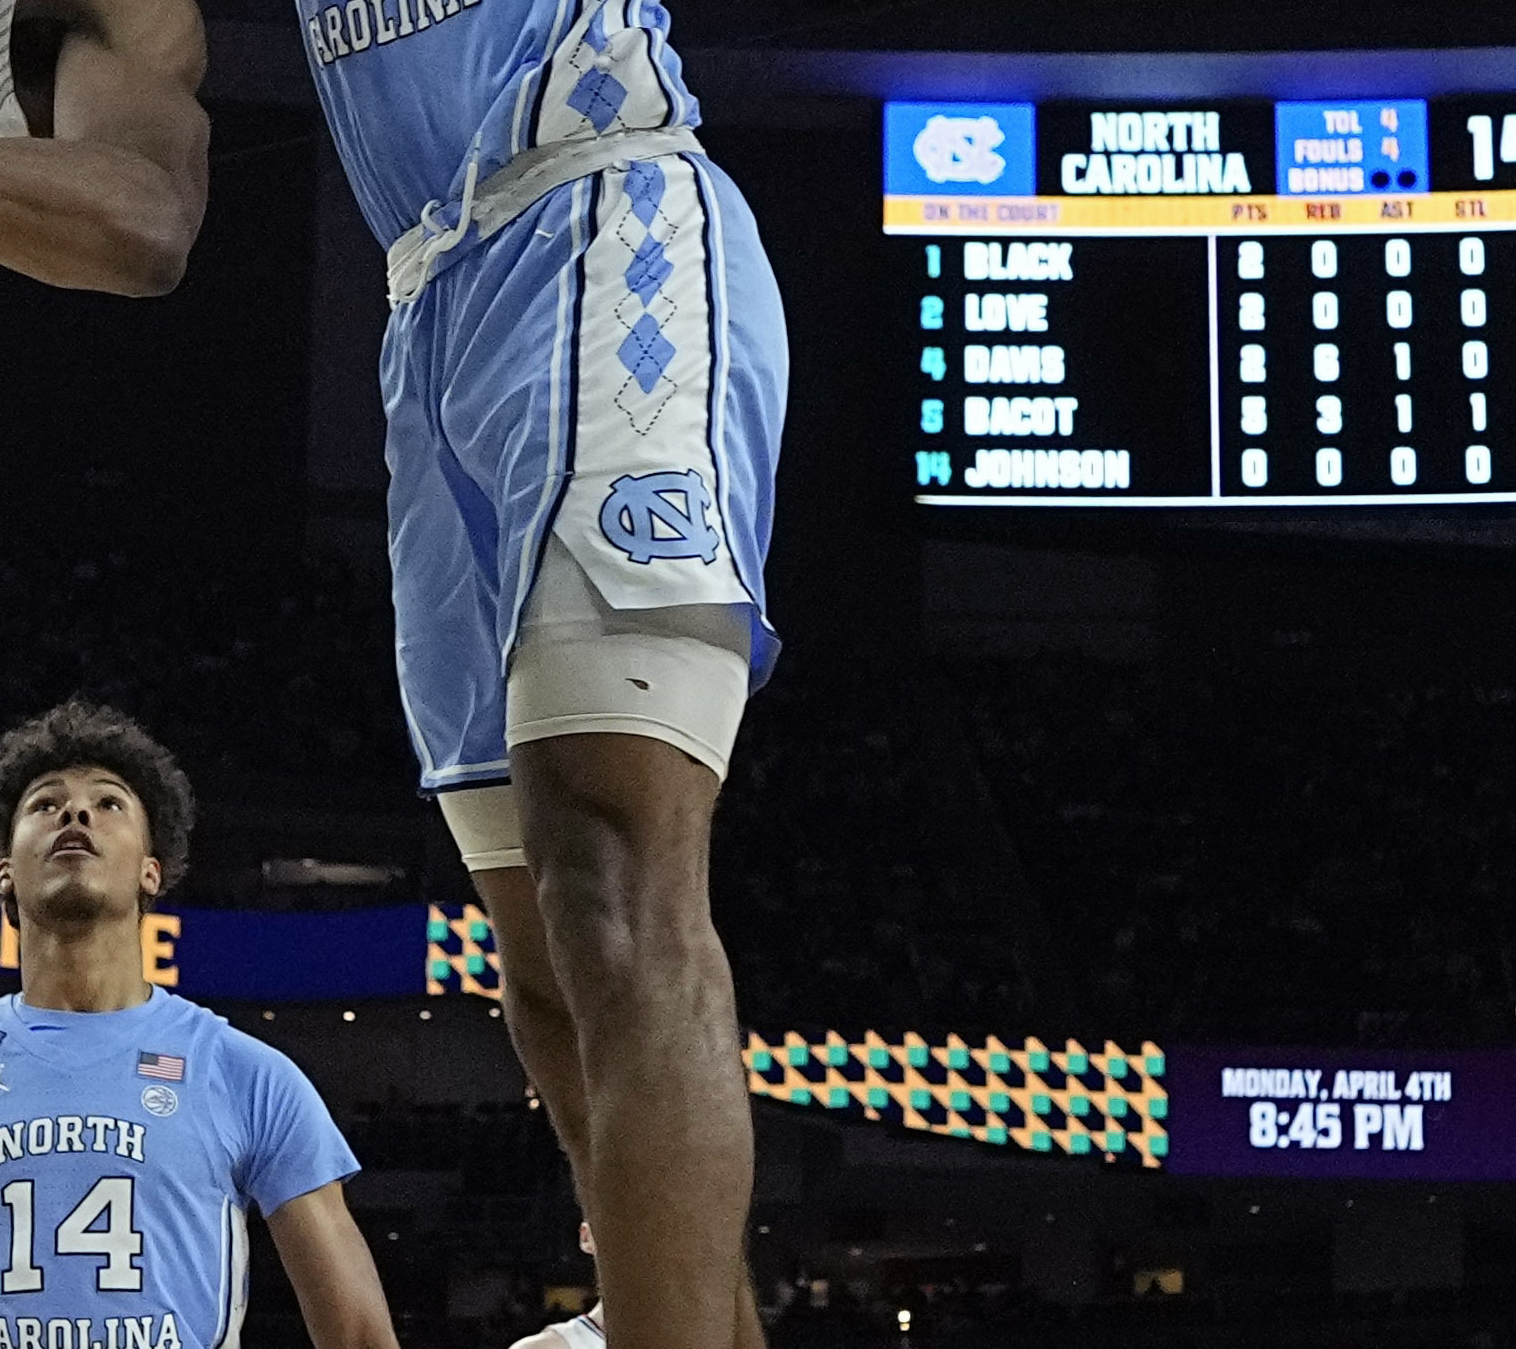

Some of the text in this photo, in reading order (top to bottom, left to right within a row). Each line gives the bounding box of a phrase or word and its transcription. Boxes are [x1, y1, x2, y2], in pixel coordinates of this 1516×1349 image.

[1091, 112, 1219, 151] NORTH
[1323, 107, 1398, 134] TOL 4
[1294, 137, 1399, 163] FOULS 4
[1061, 153, 1251, 193] CAROLINA
[1288, 167, 1364, 192] BONUS
[1381, 201, 1414, 218] AST
[925, 244, 941, 278] 1
[964, 242, 1073, 280] BLACK
[1312, 241, 1337, 278] 0
[1386, 239, 1410, 276] 0
[1460, 238, 1484, 275] 0
[920, 295, 943, 329] 2
[964, 293, 1048, 332] LOVE
[1313, 292, 1338, 329] 0
[1387, 291, 1412, 328] 0
[1461, 289, 1486, 326] 0
[920, 345, 1065, 383] 4 DAVIS
[920, 397, 1078, 435] 5 BACOT
[915, 451, 951, 485] 14
[964, 449, 1130, 489] JOHNSON
[1242, 449, 1267, 486] 0
[1316, 448, 1341, 486] 0
[1391, 447, 1416, 485] 0
[1466, 446, 1491, 483] 0
[1222, 1068, 1451, 1101] MONDAY, APRIL 4TH
[1249, 1102, 1424, 1150] 8:45 PM
[1, 1176, 144, 1294] 14
